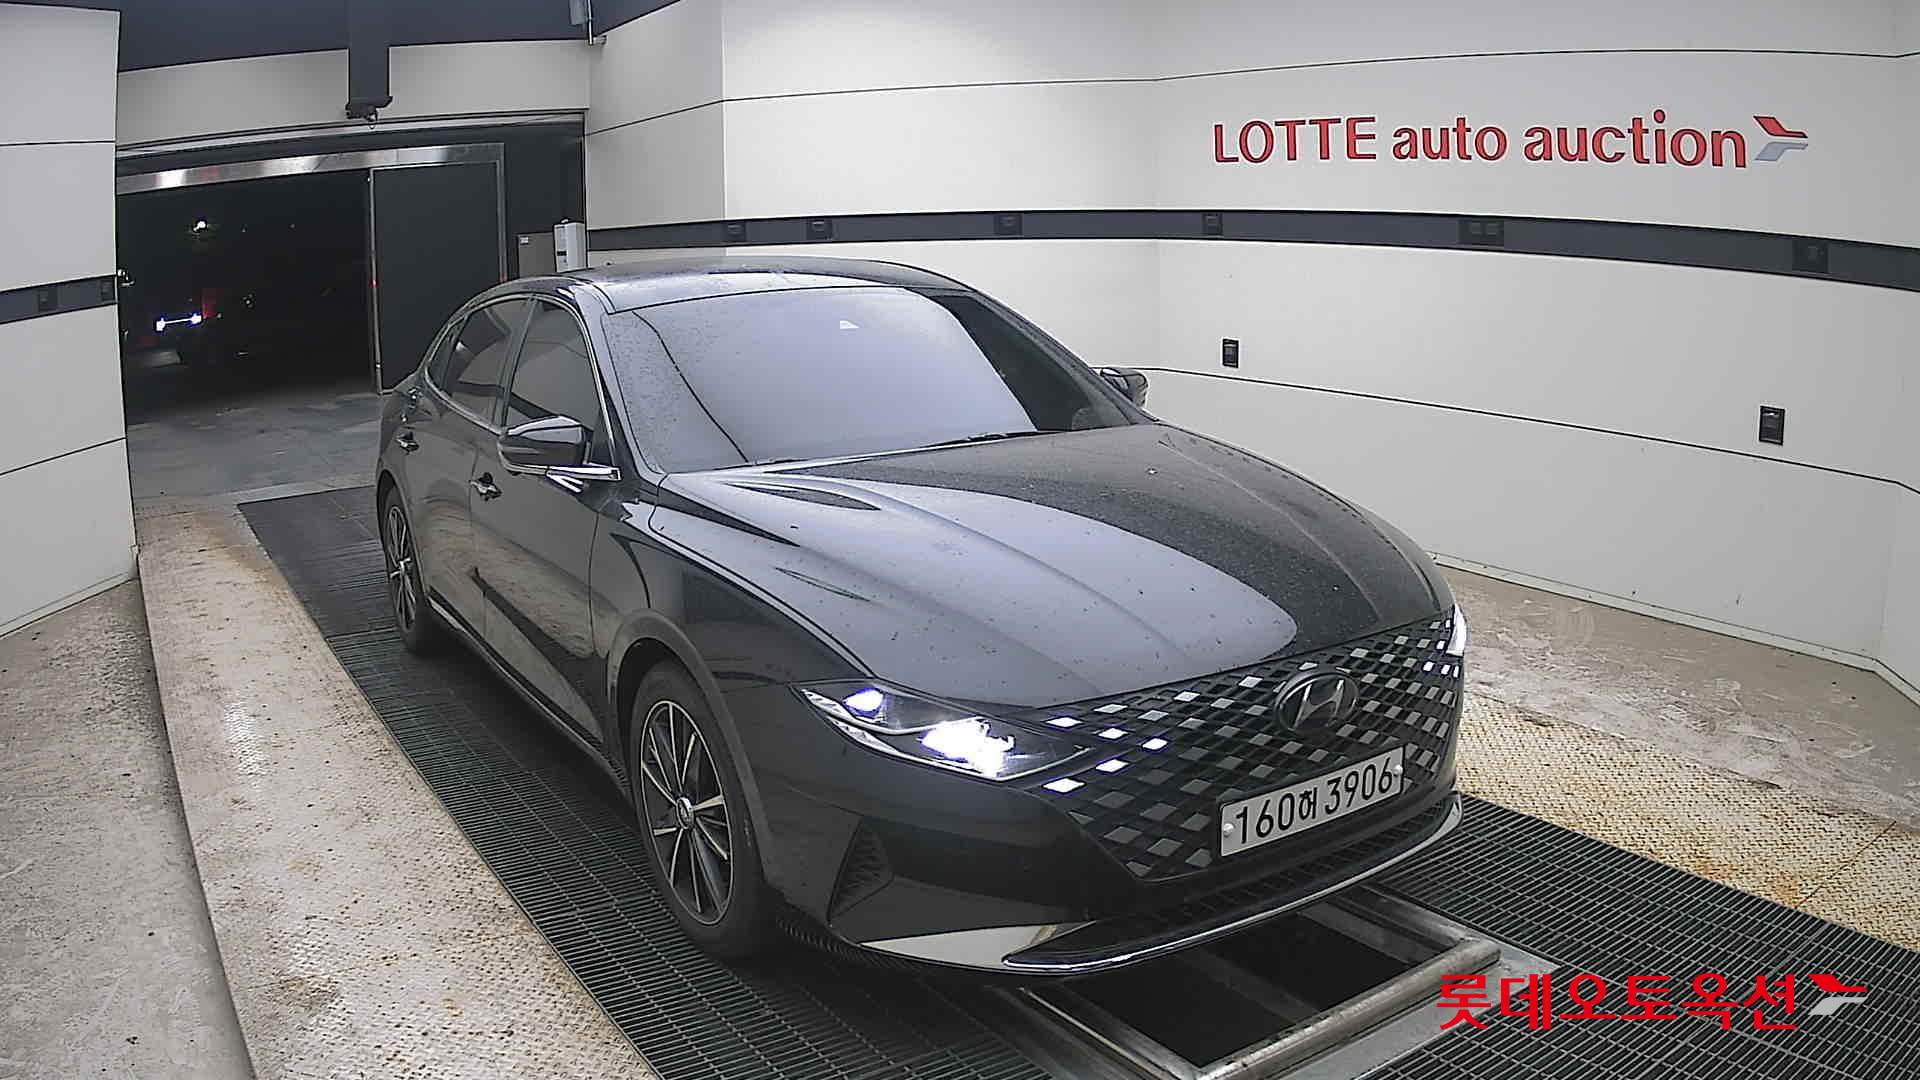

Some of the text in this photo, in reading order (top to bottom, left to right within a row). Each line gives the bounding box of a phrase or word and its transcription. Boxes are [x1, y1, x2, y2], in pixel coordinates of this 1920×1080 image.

[1213, 109, 1747, 169] LOTTE auto auction
[1324, 757, 1393, 815] 3906
